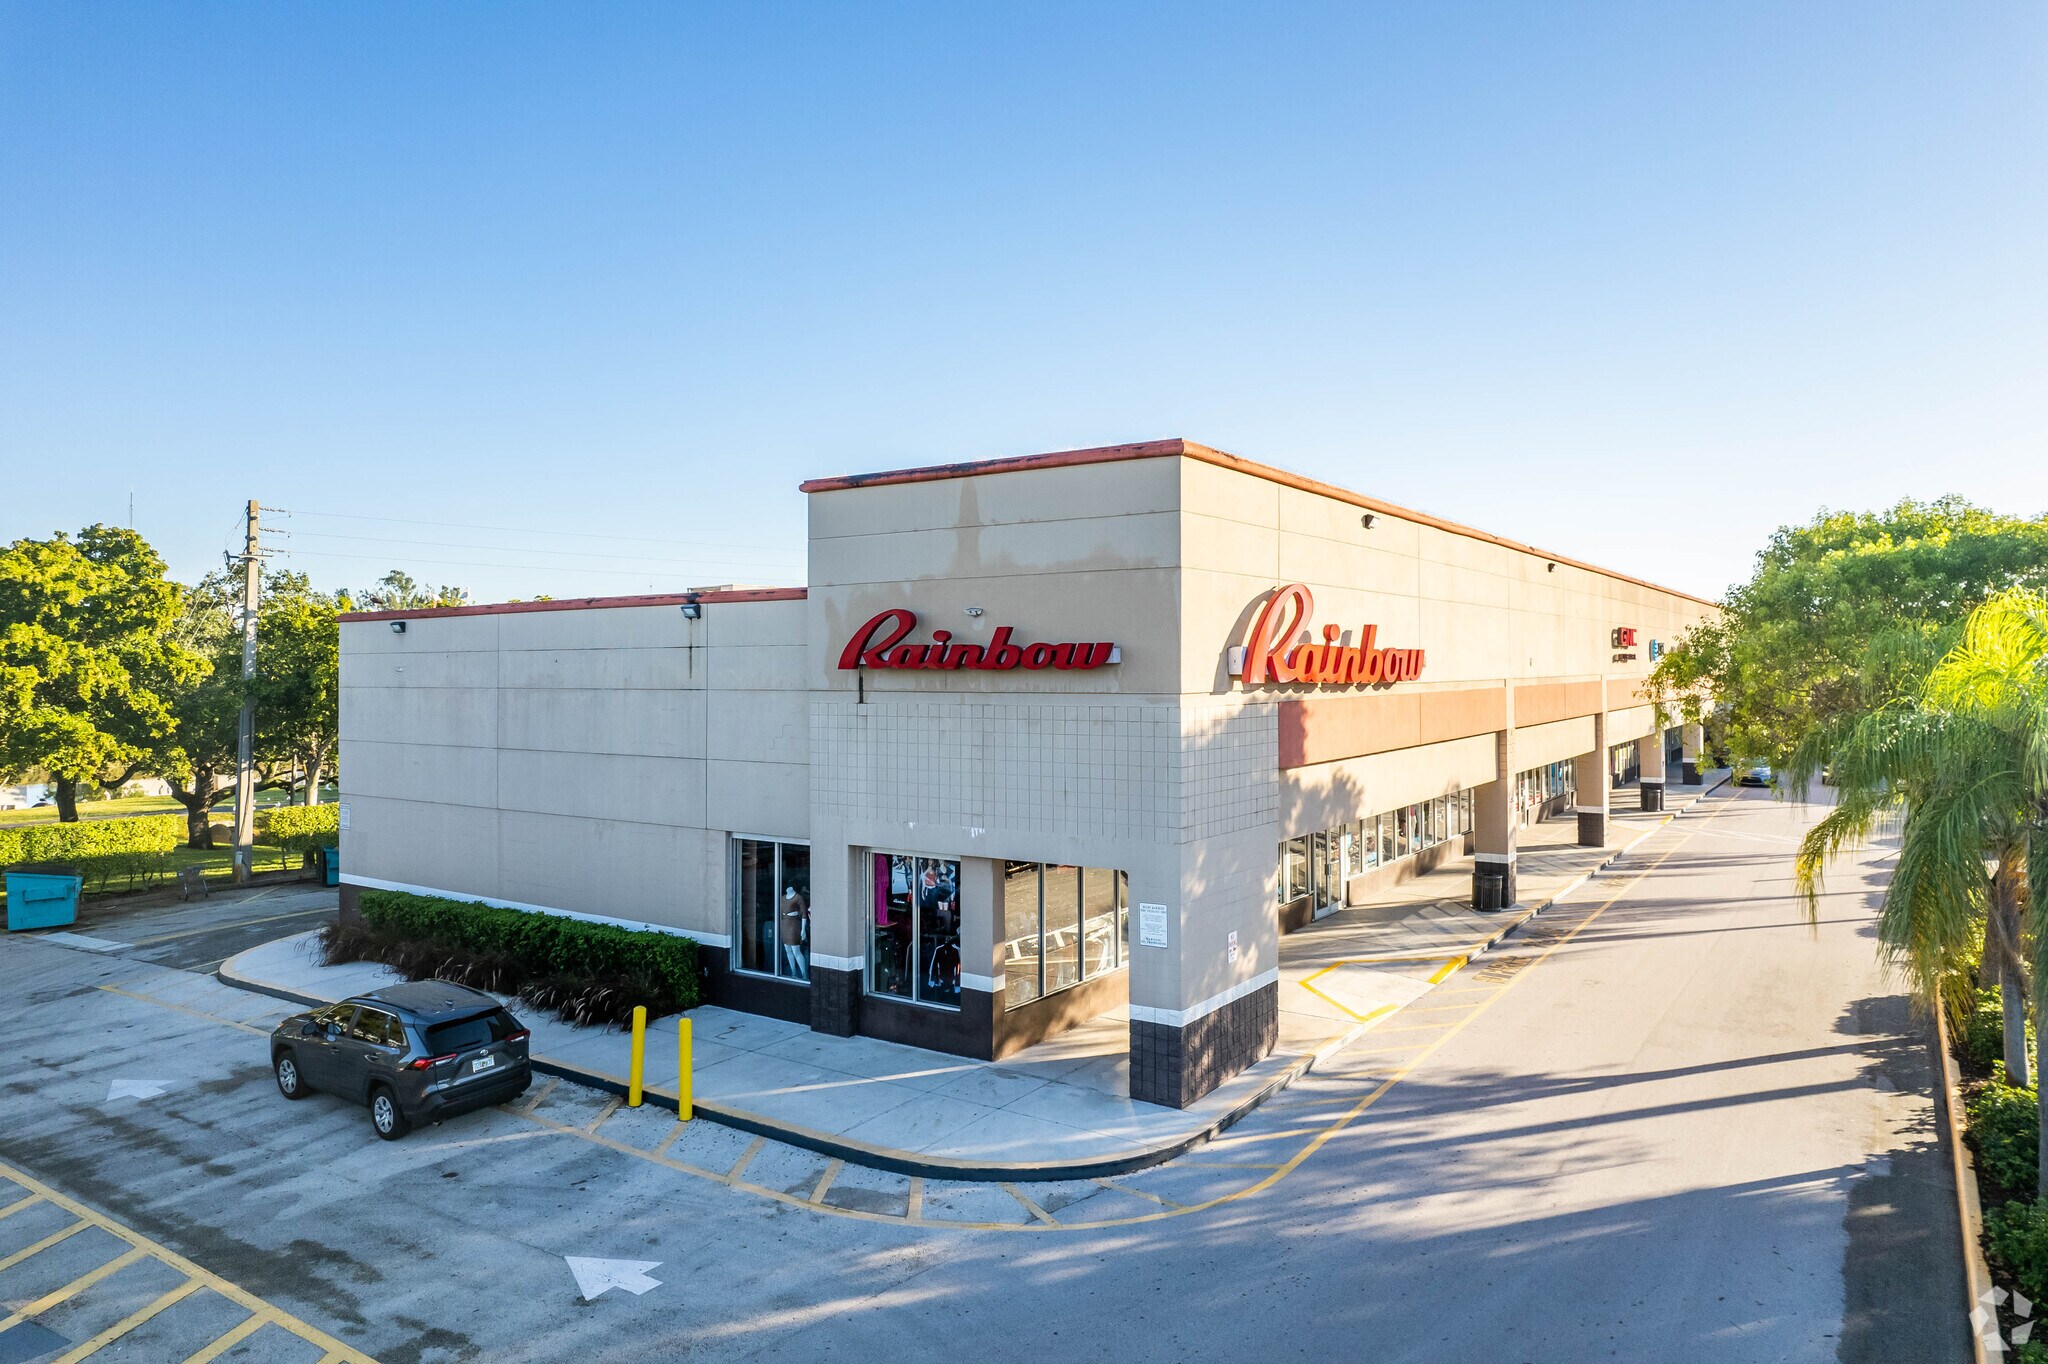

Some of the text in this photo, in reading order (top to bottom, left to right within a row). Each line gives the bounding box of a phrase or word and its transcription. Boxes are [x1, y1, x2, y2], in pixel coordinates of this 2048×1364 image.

[838, 609, 1114, 670] Rainbow
[1242, 584, 1425, 684] Rainbow
[1618, 627, 1637, 647] GNC
